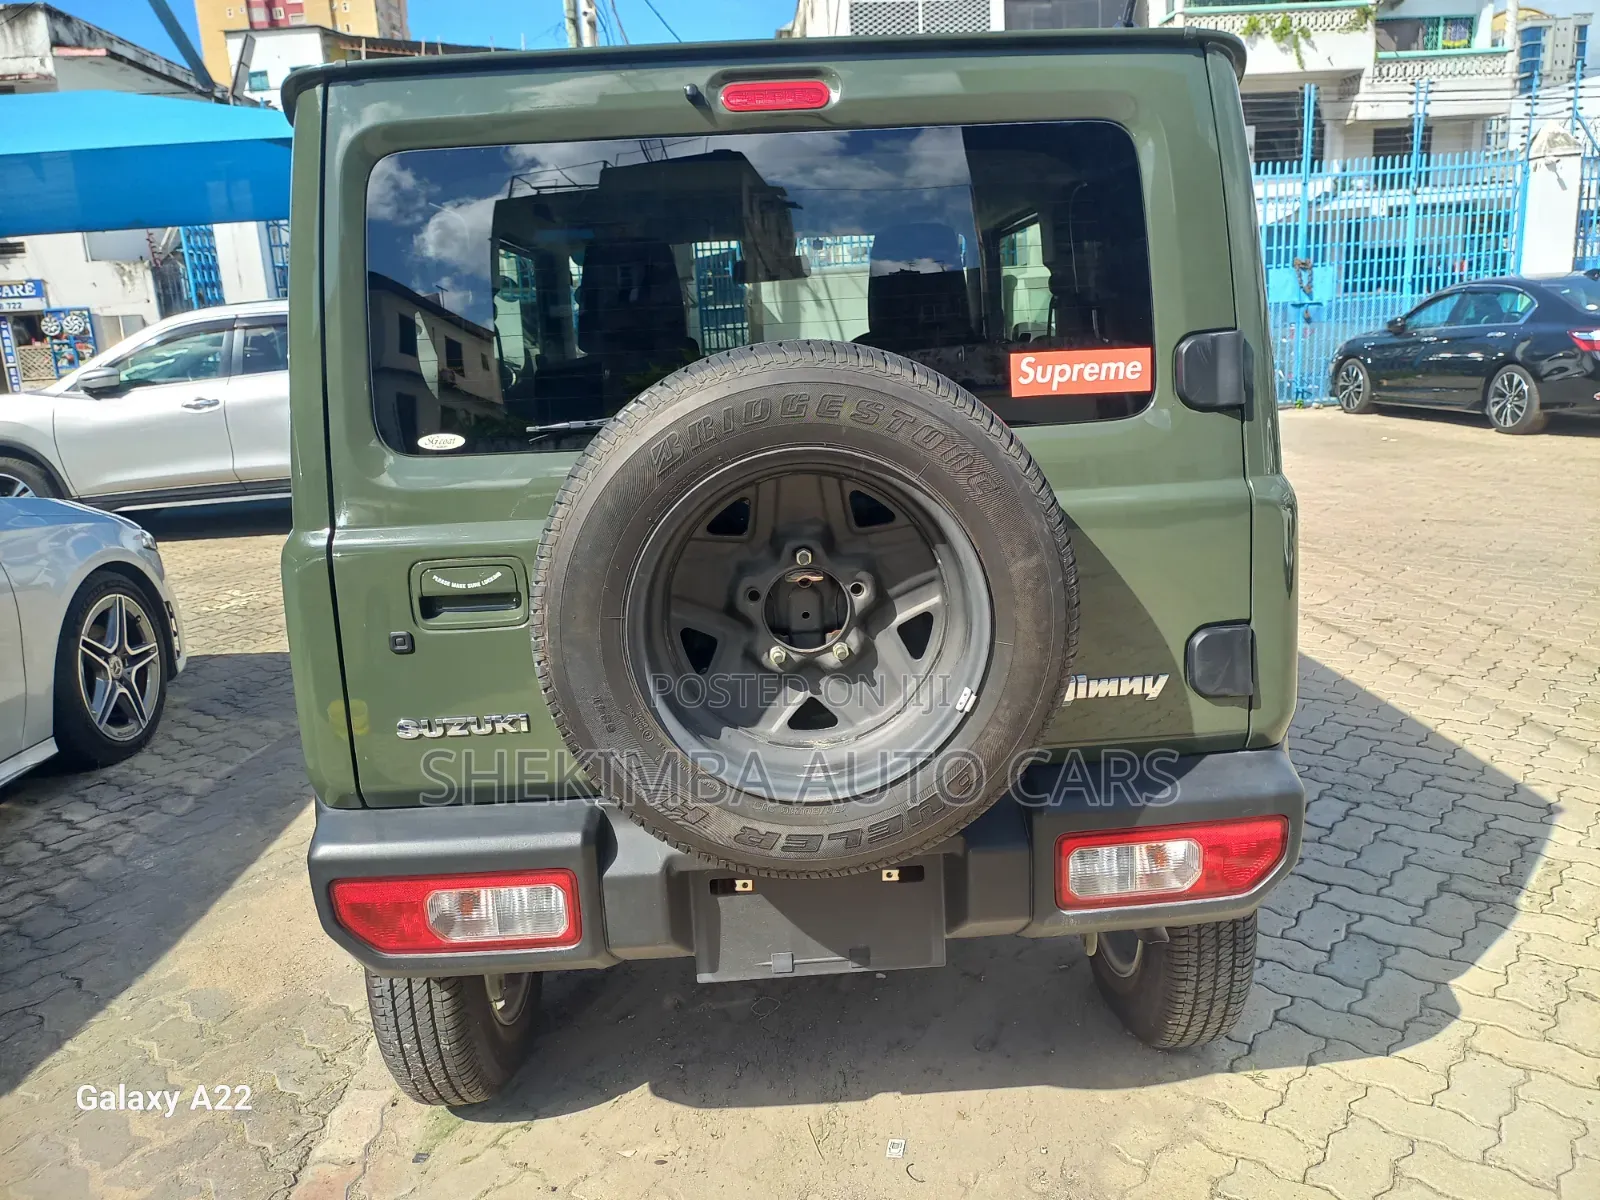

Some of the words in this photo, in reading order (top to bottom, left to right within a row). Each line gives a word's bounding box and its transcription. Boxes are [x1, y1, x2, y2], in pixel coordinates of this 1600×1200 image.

[0, 281, 36, 297] ARE
[1018, 356, 1143, 391] Supreme
[650, 391, 1000, 495] BRIDGESTONE
[432, 574, 451, 587] PLEASE
[396, 713, 531, 740] SUZUKI
[732, 758, 983, 853] DUELER
